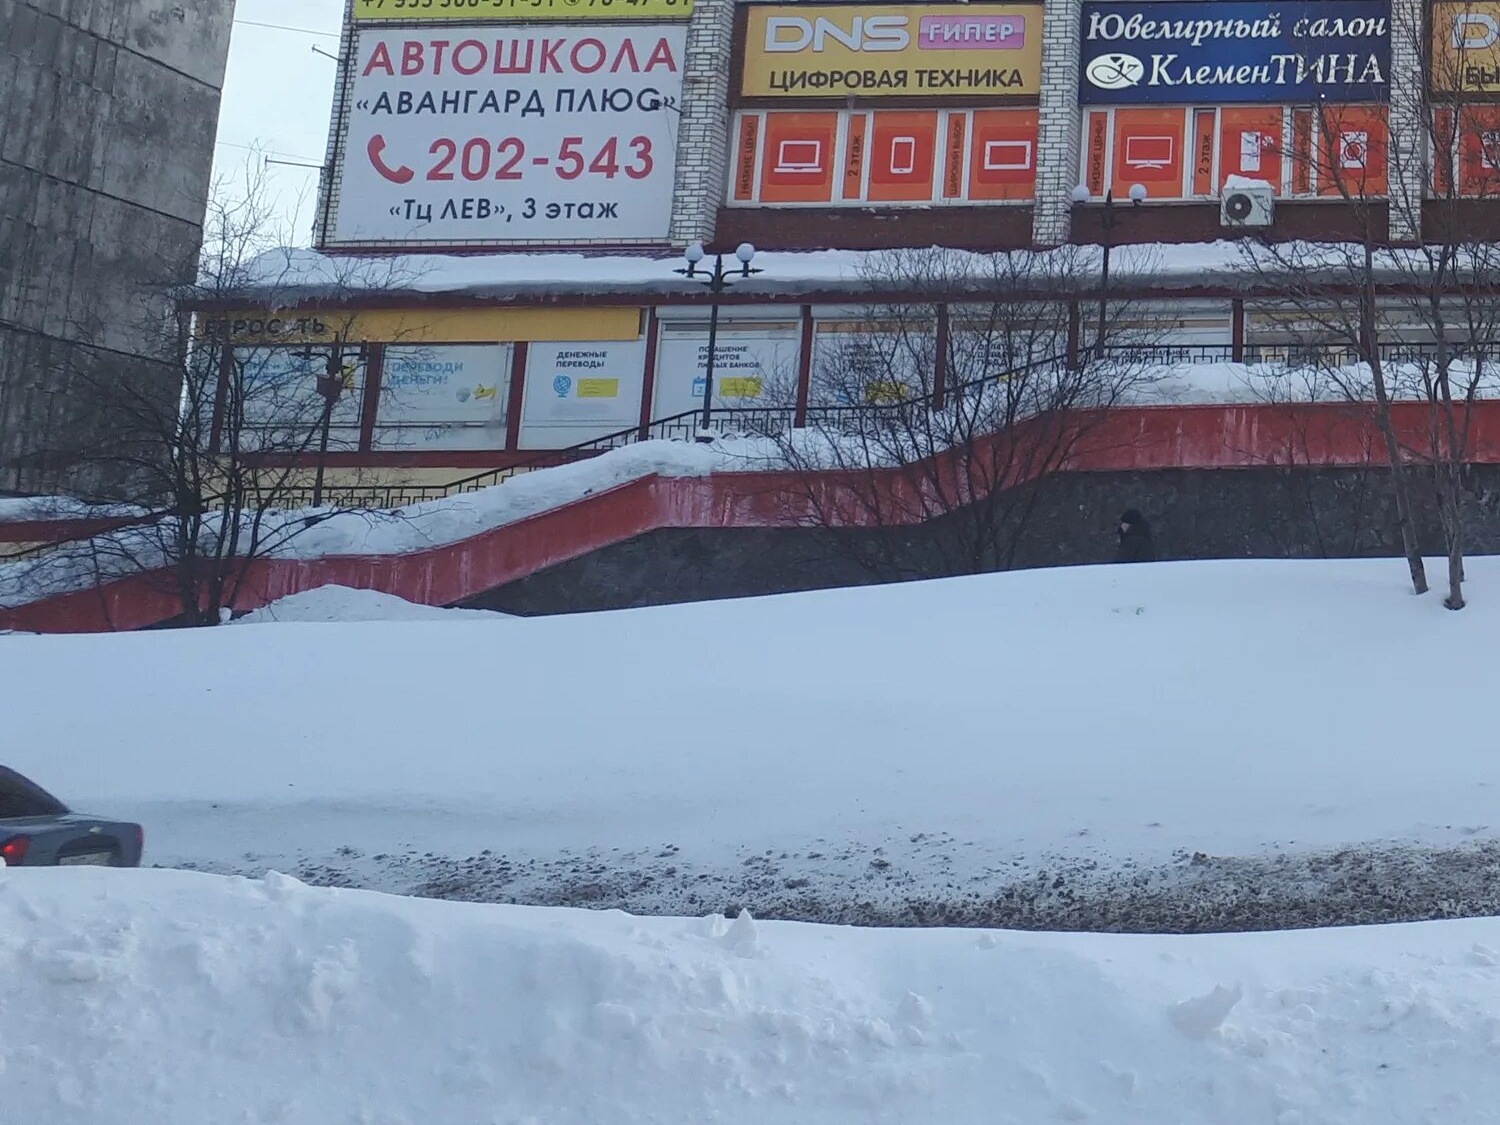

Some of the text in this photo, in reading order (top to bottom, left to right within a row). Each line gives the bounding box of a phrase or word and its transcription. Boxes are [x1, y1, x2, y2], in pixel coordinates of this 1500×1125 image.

[763, 15, 910, 53] DNS
[927, 24, 1016, 43] ГИПЕР
[1086, 11, 1387, 46] Ювелирный салон
[362, 37, 678, 77] АВТОШКОЛА
[1148, 53, 1386, 87] КлеменТИНА
[769, 68, 1024, 92] ЦИФРОВАЯ ТЕХНИКА
[356, 87, 677, 118] «АВАНГАРД ПЛЮС»
[426, 135, 655, 182] 202-543
[847, 134, 862, 178] 2 этаж
[1198, 133, 1212, 176] 2 этаж
[441, 196, 513, 223] ЛЕВ»,
[521, 197, 536, 220] 3
[546, 199, 619, 220] этаж
[555, 360, 605, 369] ПЕРЕВОДЫ
[556, 351, 608, 360] ДЕНЕЖНЫЕ
[698, 345, 747, 353] ПОАШЕНИЕ
[729, 361, 761, 369] БАНКОВ
